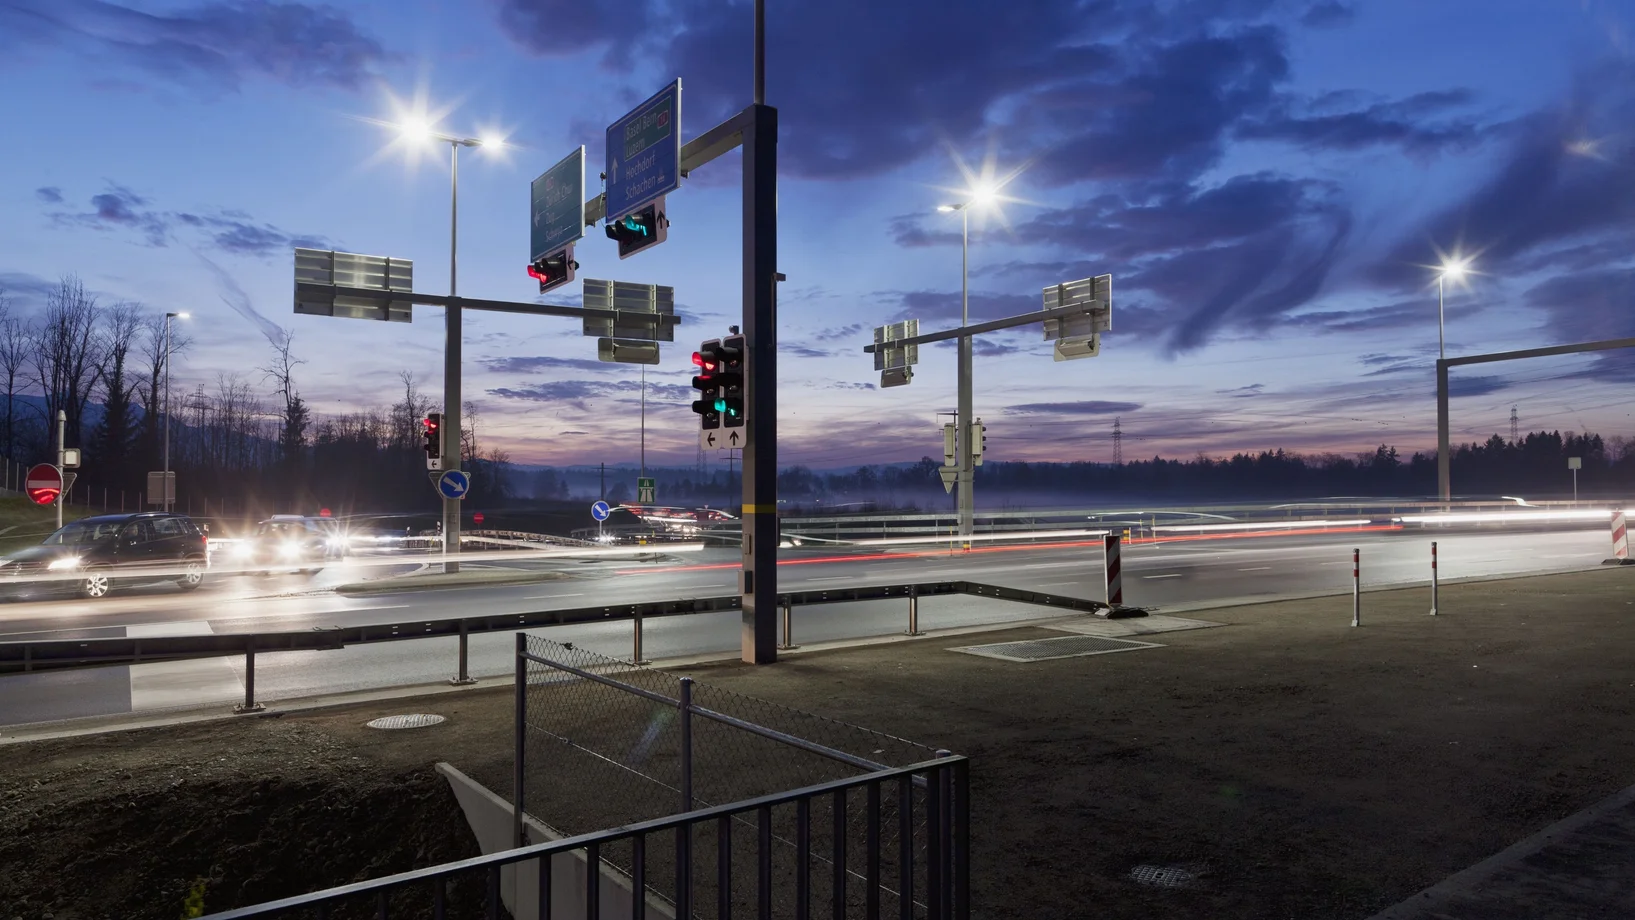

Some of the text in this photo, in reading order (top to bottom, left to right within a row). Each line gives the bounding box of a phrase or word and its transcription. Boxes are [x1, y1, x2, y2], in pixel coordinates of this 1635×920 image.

[626, 117, 642, 140] Basel
[643, 112, 656, 130] Bern
[626, 137, 645, 158] Luzern
[625, 149, 656, 180] Hochdorf
[625, 175, 656, 200] Schachen
